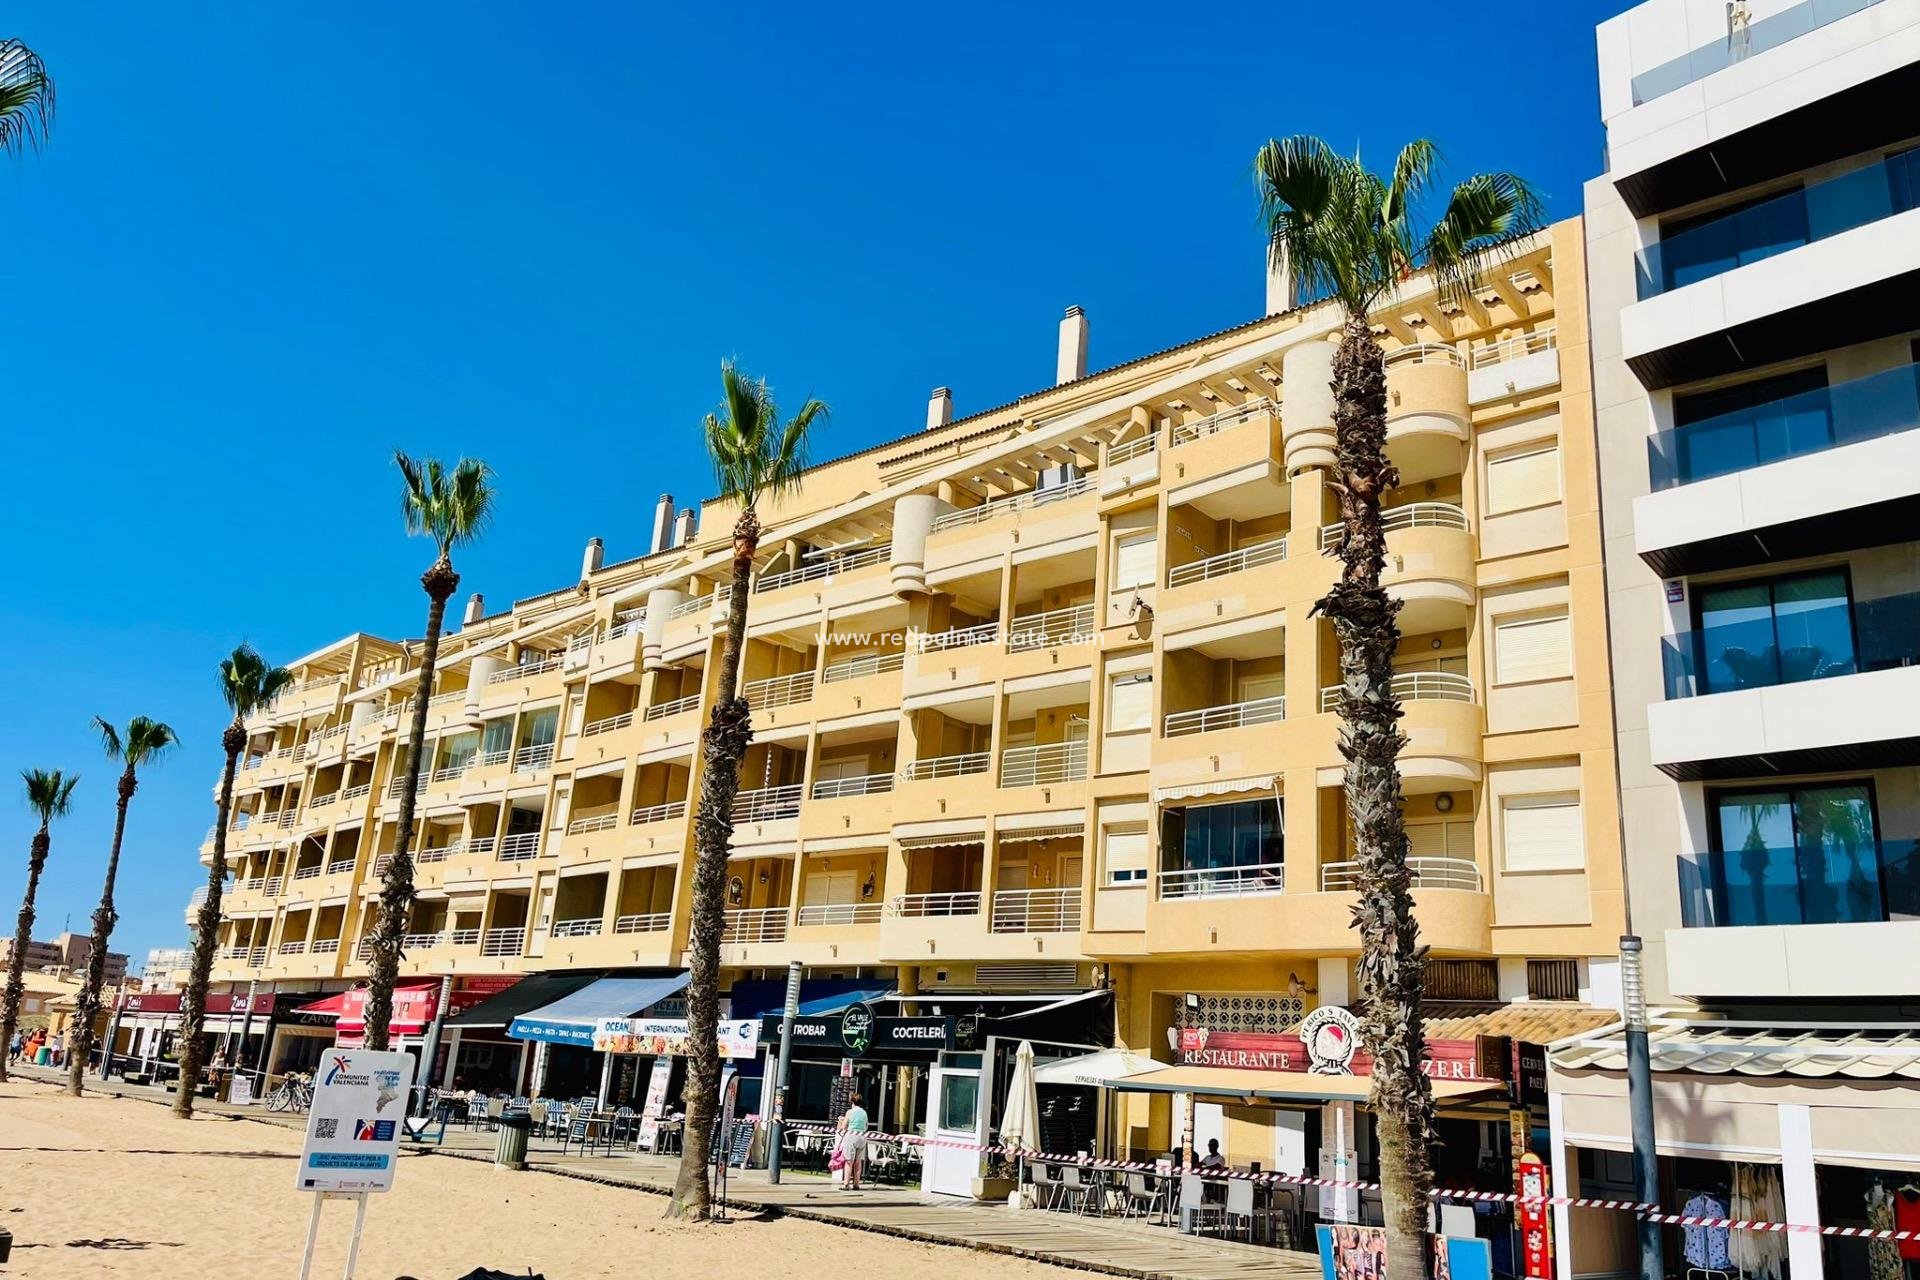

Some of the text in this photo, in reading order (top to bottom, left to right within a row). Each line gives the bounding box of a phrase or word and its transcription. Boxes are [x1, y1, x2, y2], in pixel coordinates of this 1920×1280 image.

[605, 1021, 689, 1034] OCEAN INTERNATIONAL
[777, 1024, 826, 1036] GTROBAR
[1301, 1010, 1325, 1038] PERICO
[1183, 1049, 1290, 1069] RESTAURANTE
[1522, 1057, 1545, 1071] CERVEC
